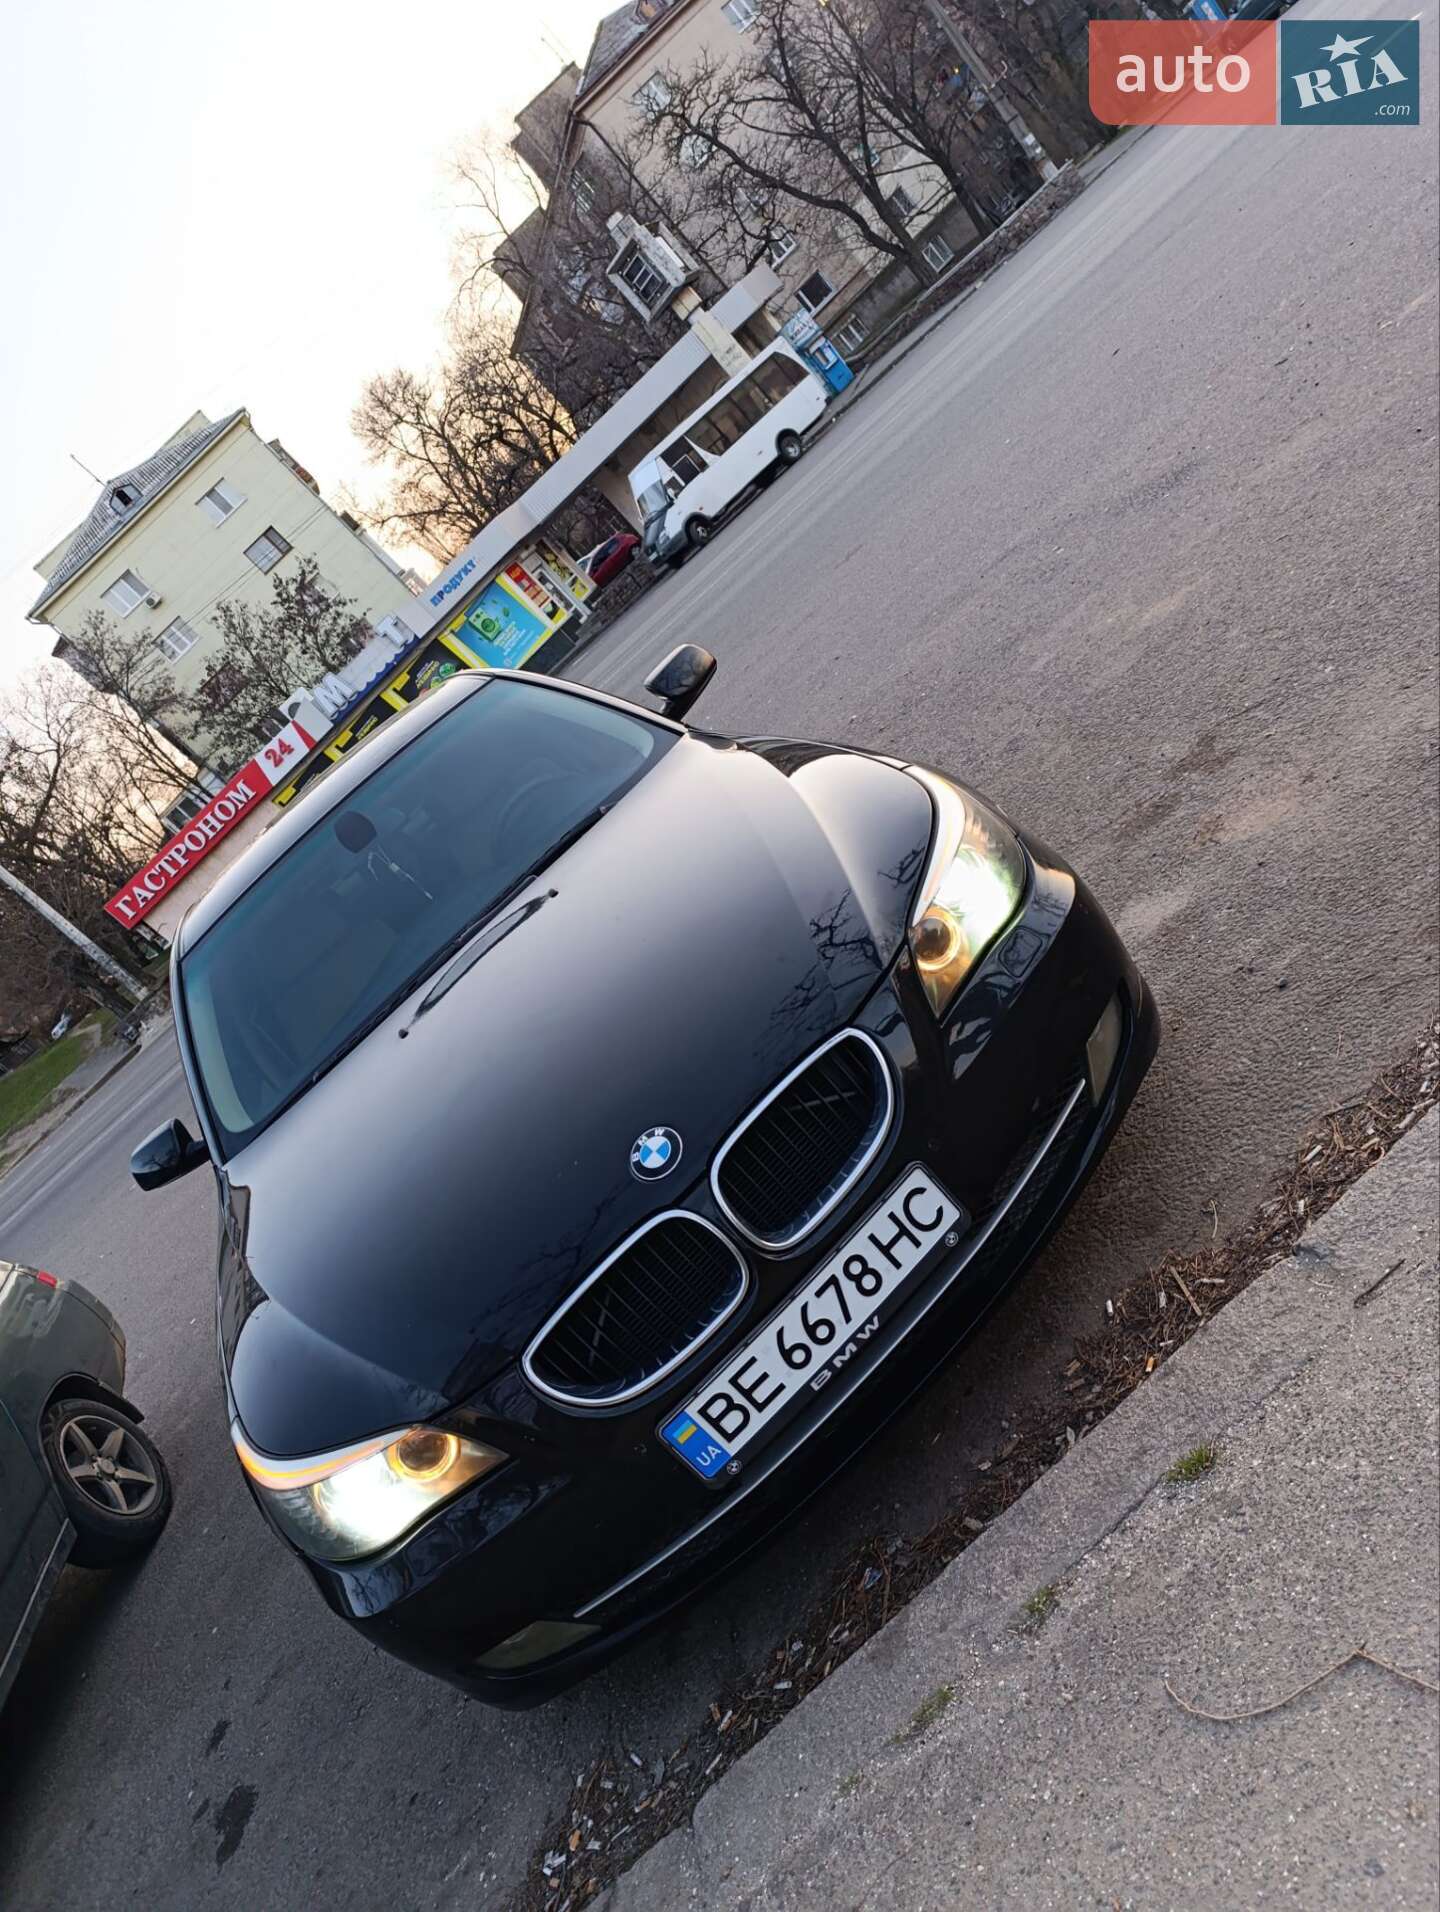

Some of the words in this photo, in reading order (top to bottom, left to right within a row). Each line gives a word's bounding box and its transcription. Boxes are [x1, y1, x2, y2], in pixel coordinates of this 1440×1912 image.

[114, 779, 258, 922] ГАСТРОНОМ
[264, 737, 295, 769] 24
[697, 1356, 786, 1444] BE
[776, 1253, 883, 1370] 6678
[868, 1187, 944, 1270] HC
[810, 1315, 881, 1392] BMW
[696, 1444, 722, 1467] UA
